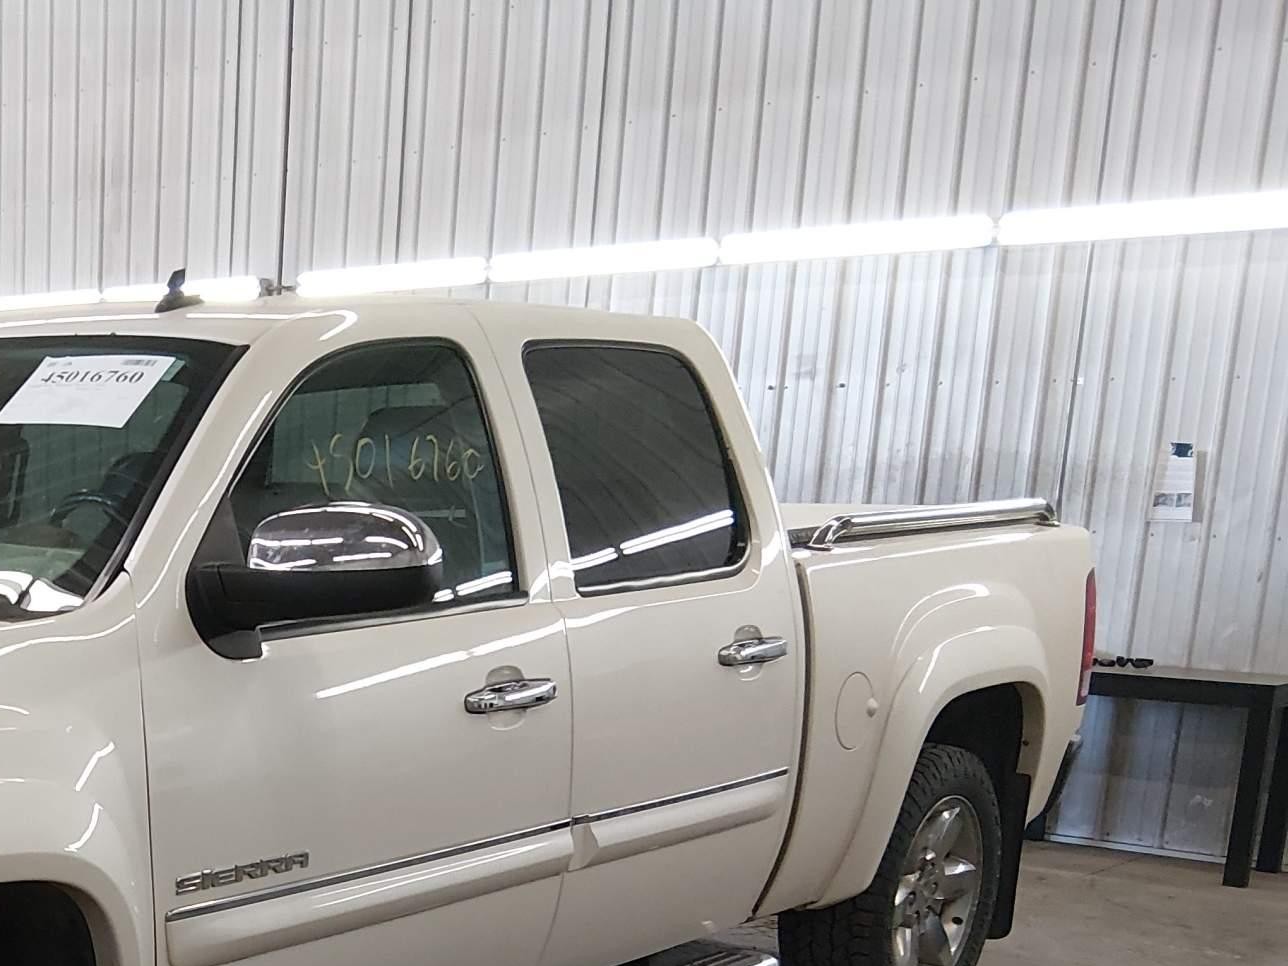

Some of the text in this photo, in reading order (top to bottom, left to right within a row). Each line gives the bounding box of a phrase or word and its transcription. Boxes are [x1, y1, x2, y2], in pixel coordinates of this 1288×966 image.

[40, 369, 145, 384] 45016760
[305, 433, 484, 496] 45016760
[176, 850, 309, 895] SIERRA
